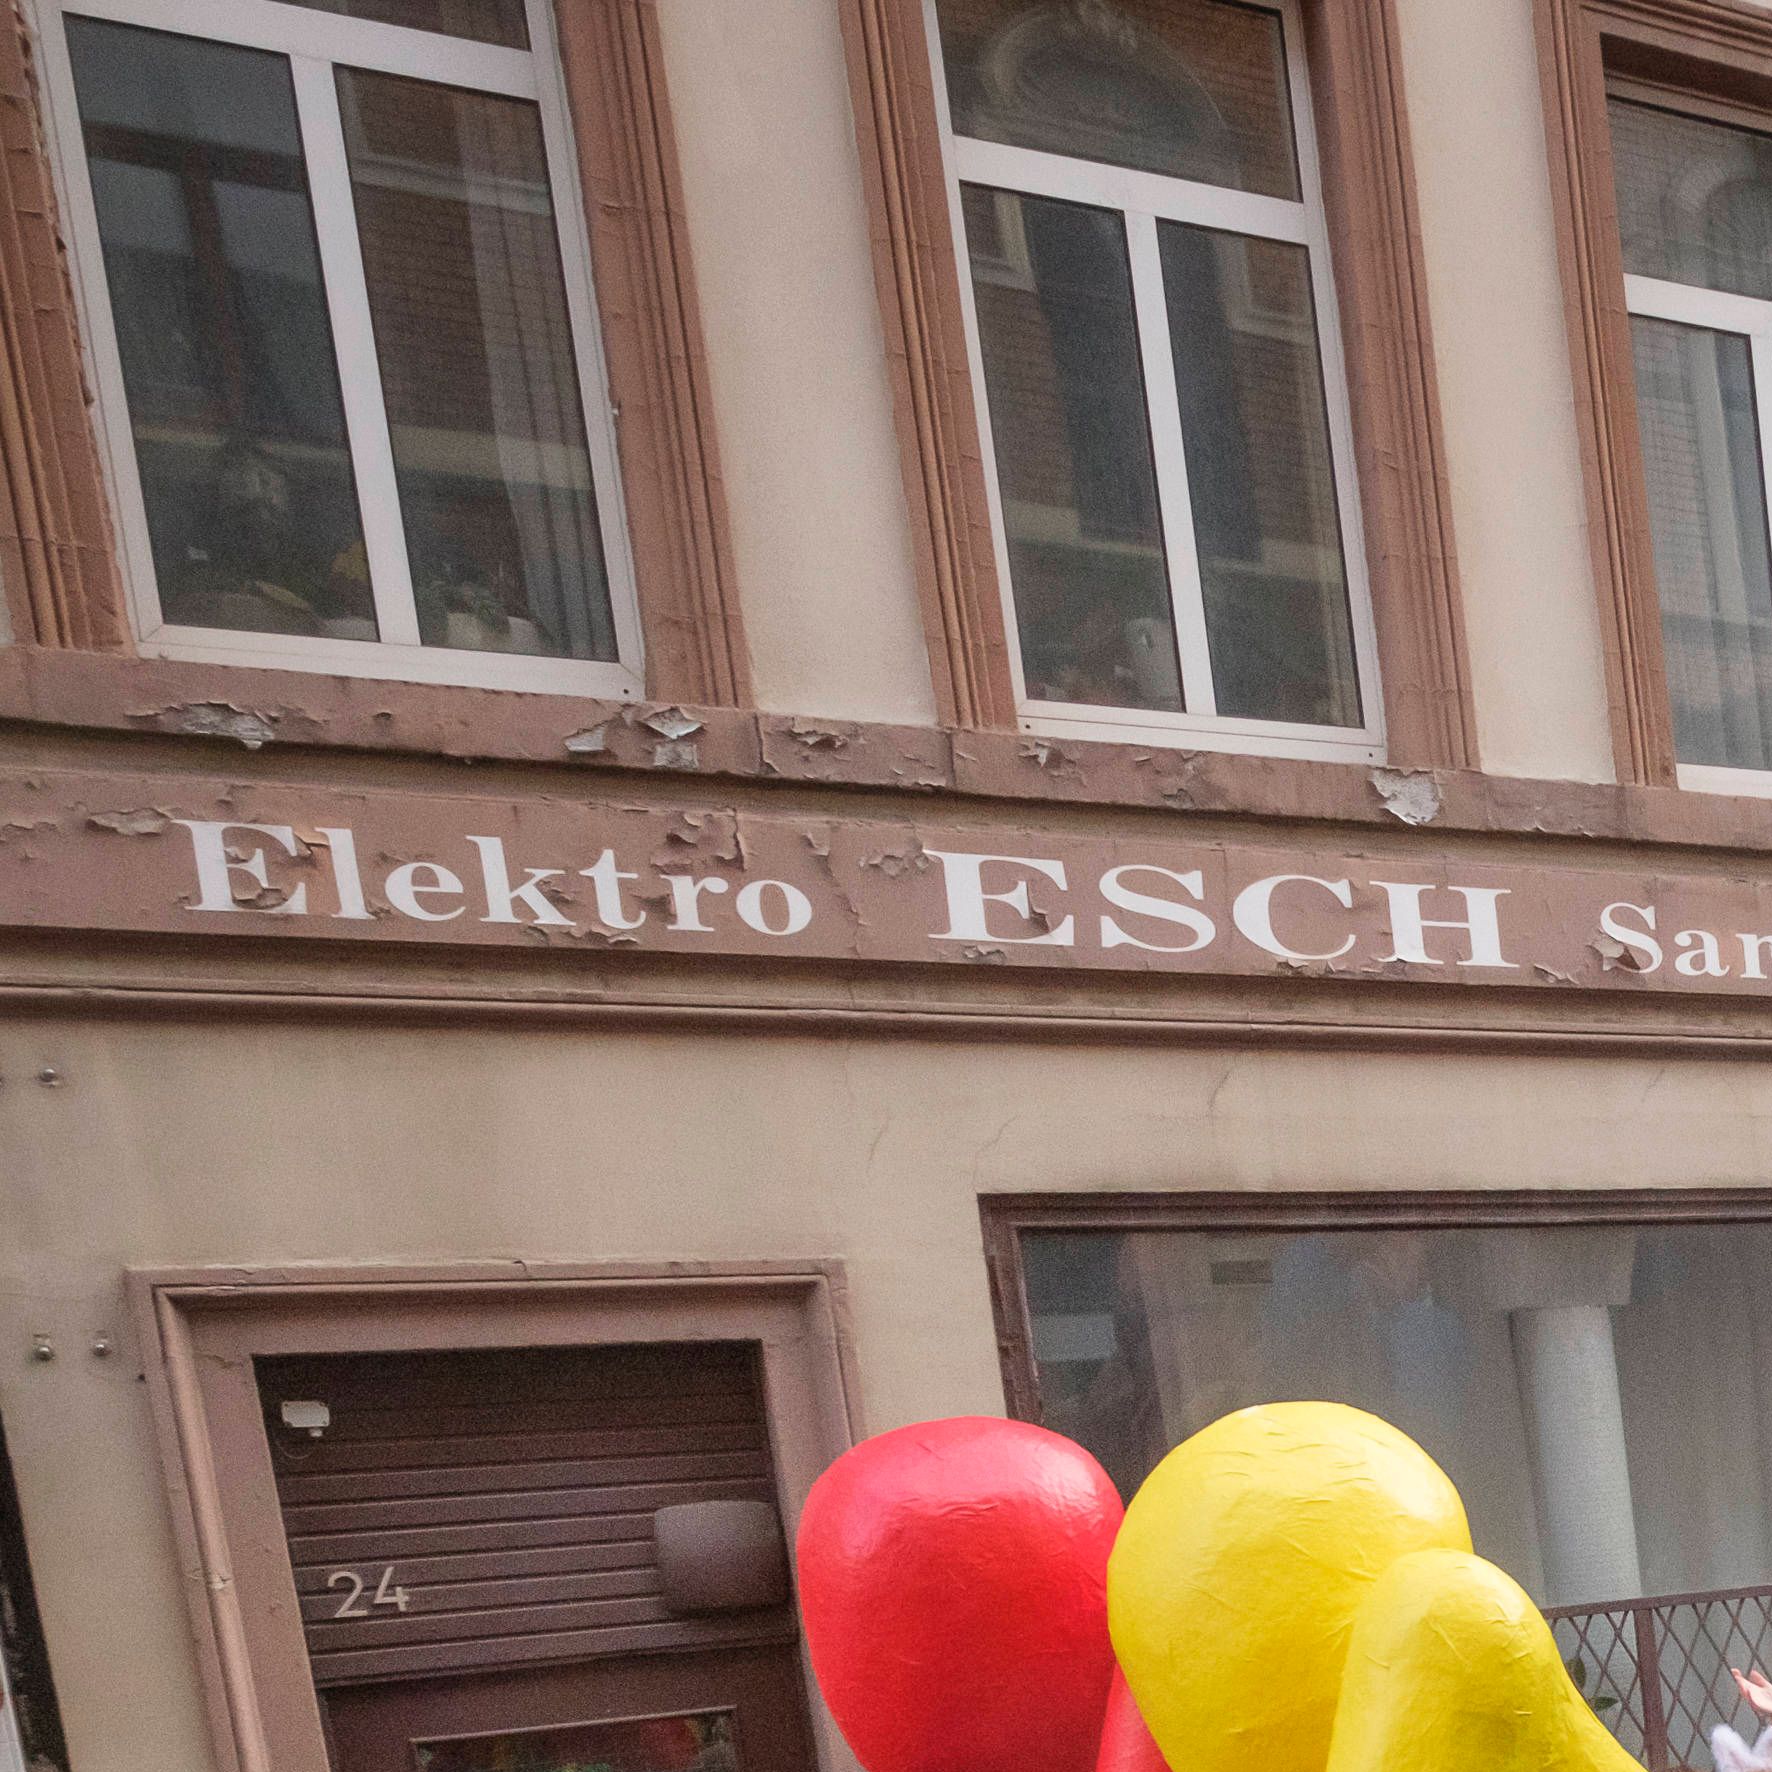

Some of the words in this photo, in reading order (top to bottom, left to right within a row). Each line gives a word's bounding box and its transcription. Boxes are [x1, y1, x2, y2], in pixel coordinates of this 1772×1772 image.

[173, 818, 813, 936] Elektro
[923, 848, 1519, 969] ESCH
[326, 1566, 411, 1620] 24
